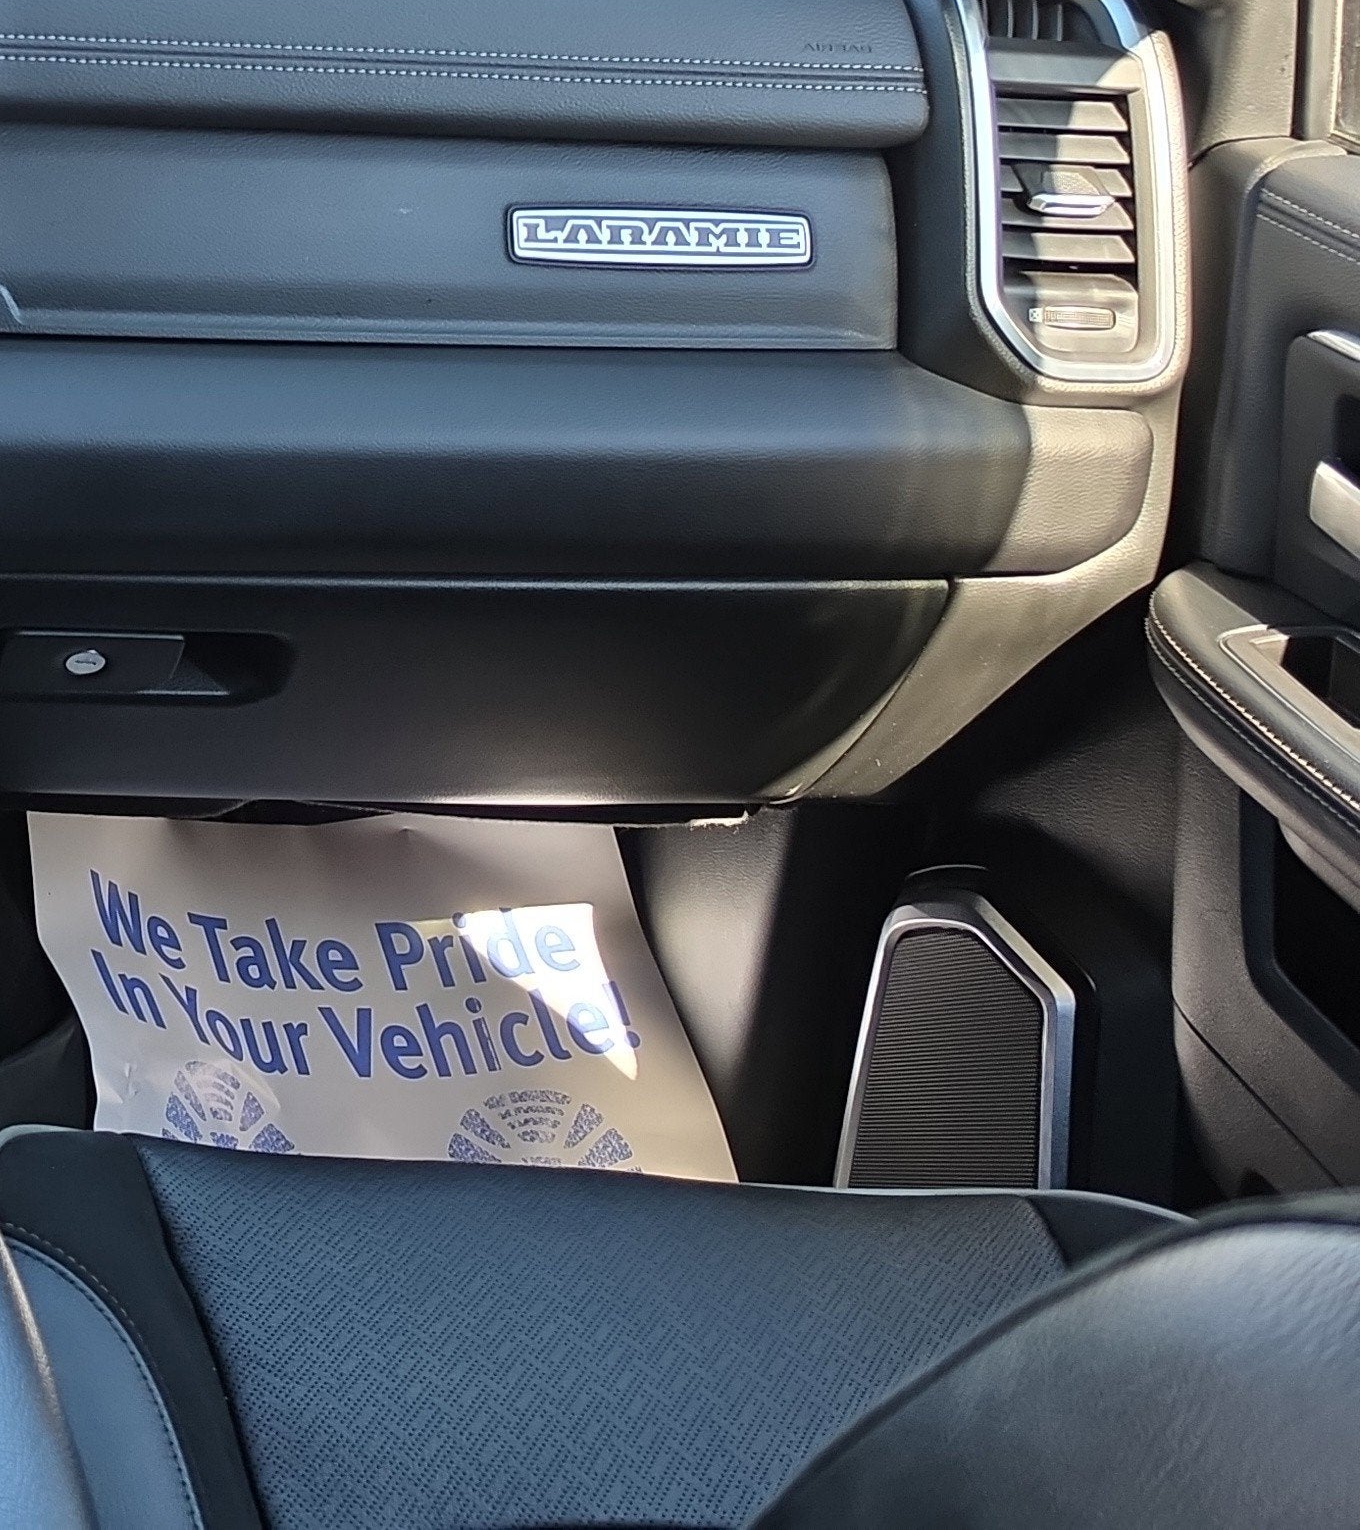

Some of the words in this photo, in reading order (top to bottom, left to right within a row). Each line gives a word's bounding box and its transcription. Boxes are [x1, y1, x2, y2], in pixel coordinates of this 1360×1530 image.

[522, 220, 802, 249] LARAMIE
[88, 868, 187, 970] We
[187, 911, 362, 993] Take
[375, 908, 584, 993] Pride
[89, 948, 167, 1031] In
[158, 973, 311, 1076] Your
[318, 978, 643, 1081] Vehicle!
